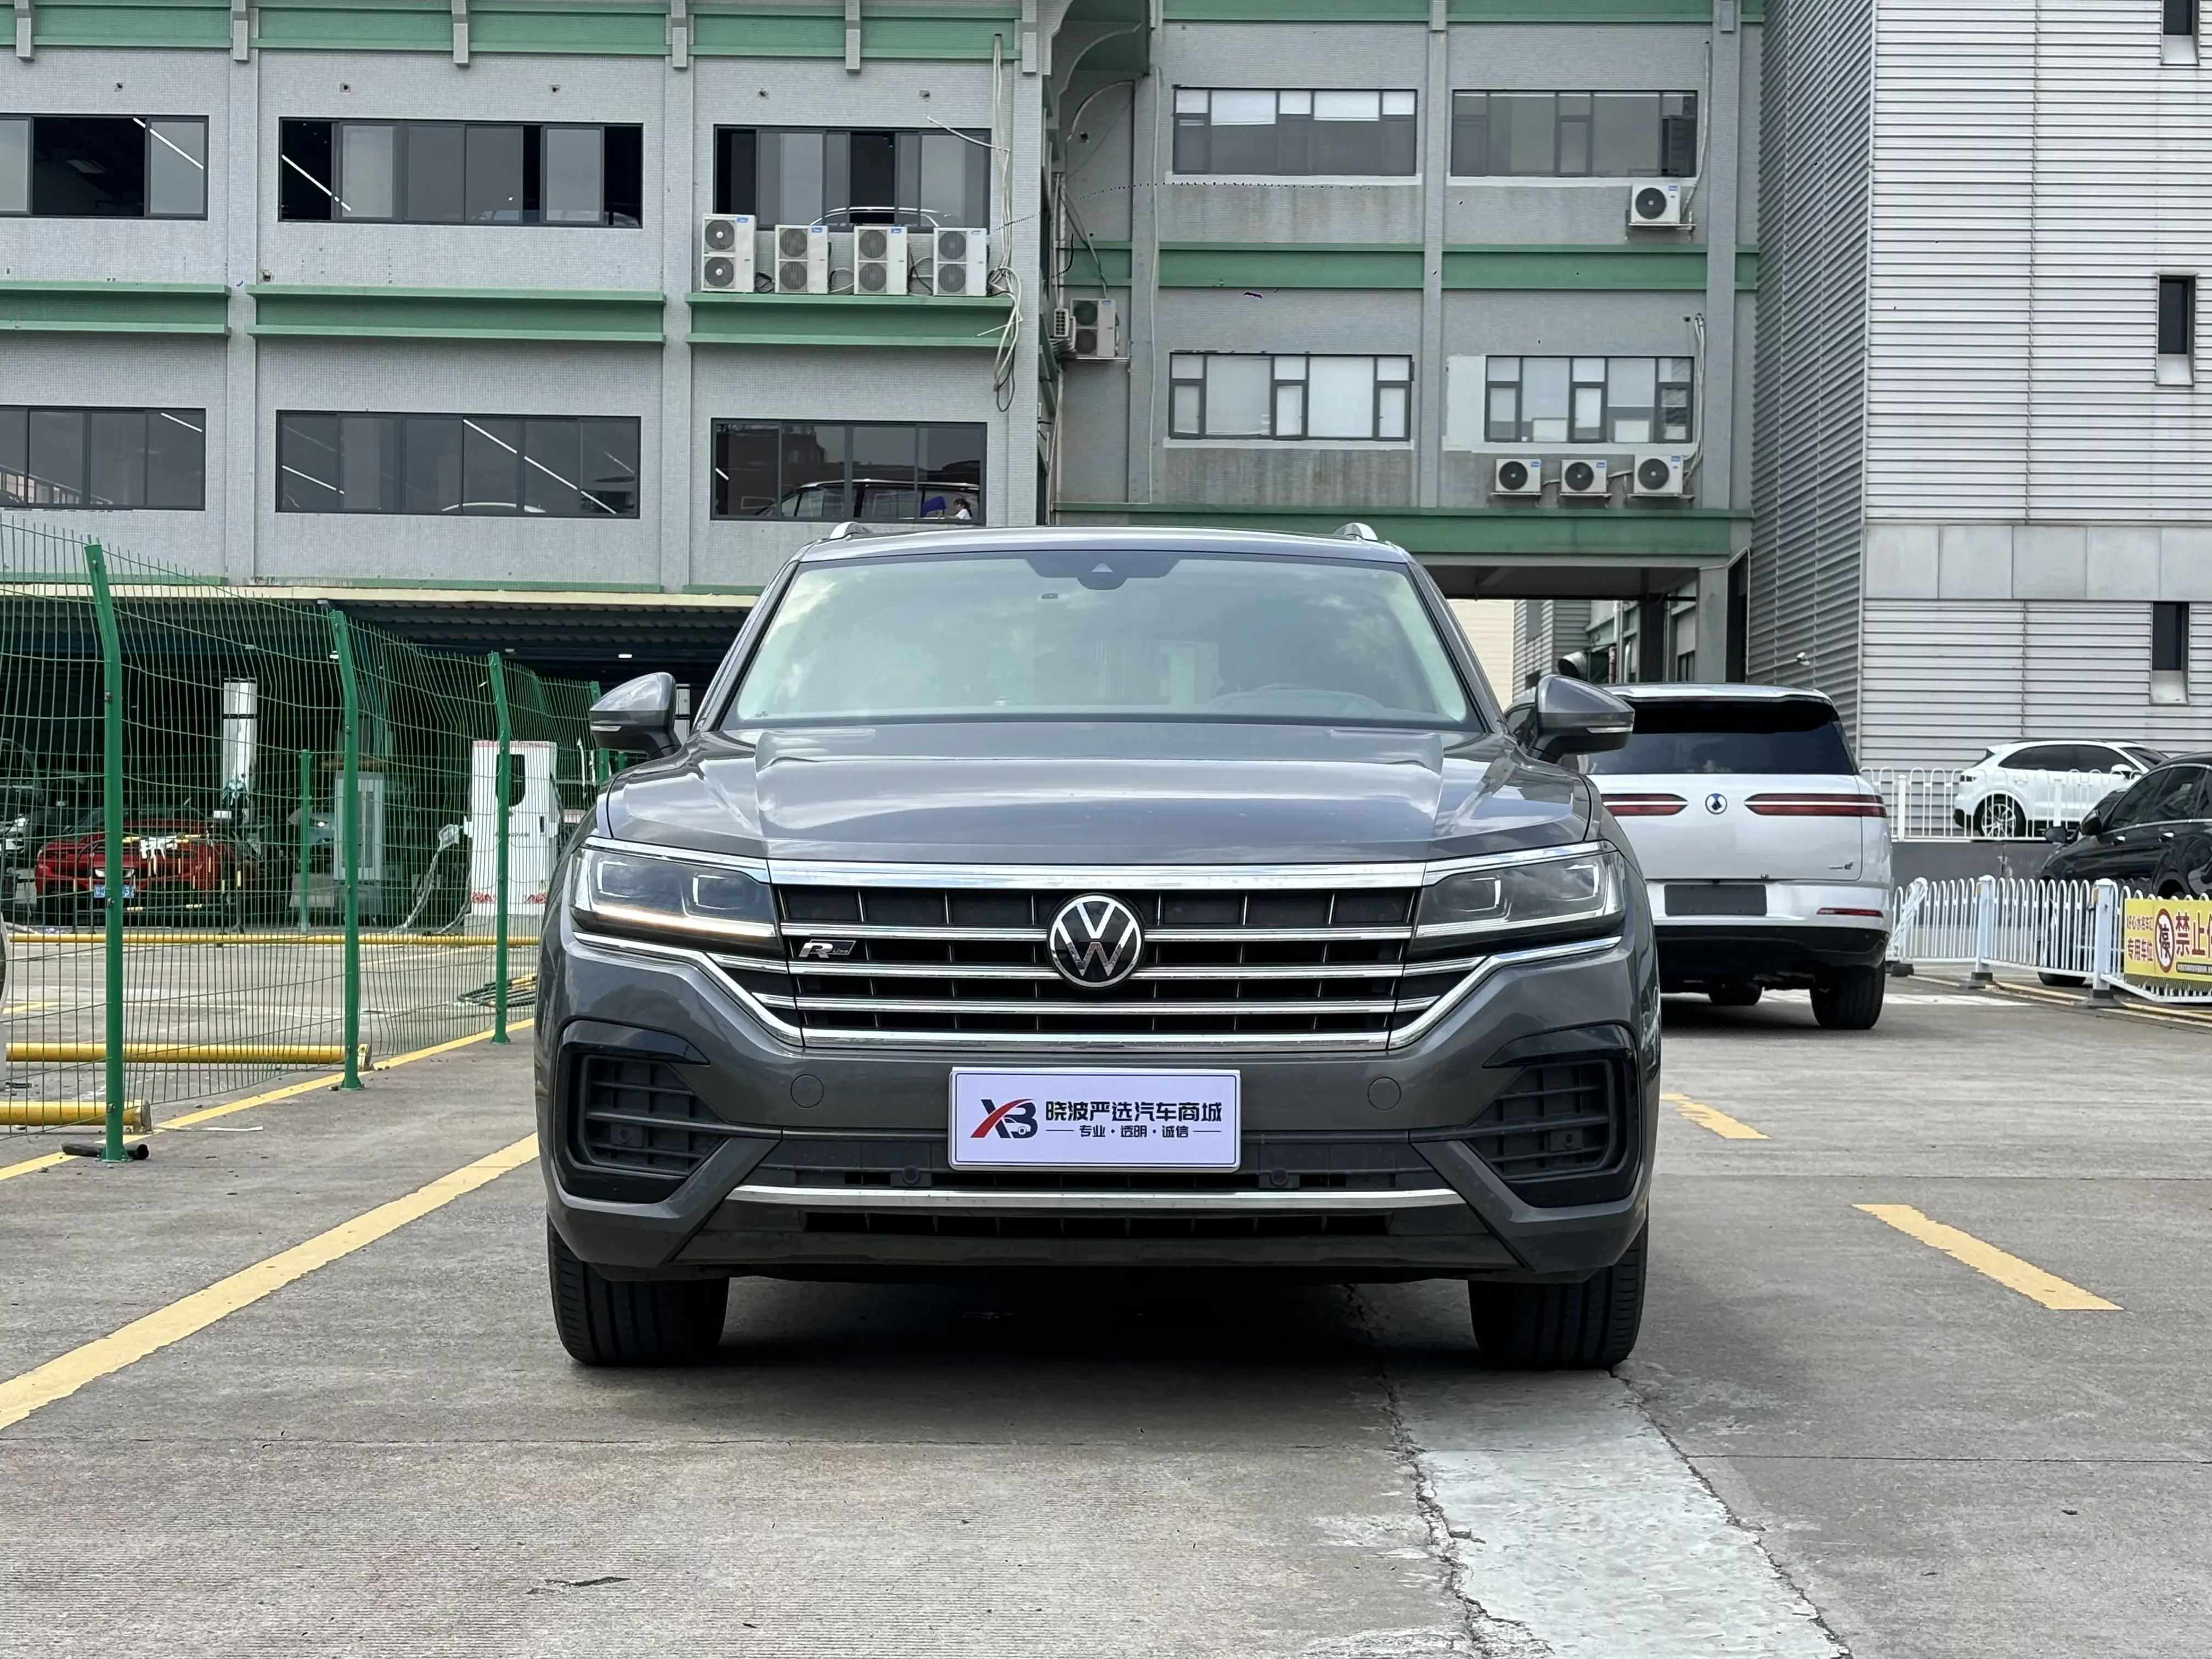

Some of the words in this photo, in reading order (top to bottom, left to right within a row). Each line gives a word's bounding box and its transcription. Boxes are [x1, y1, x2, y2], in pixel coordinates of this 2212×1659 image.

[2127, 937, 2153, 962] 专用车位
[1045, 1101, 1222, 1122] 晓波严选汽车商城
